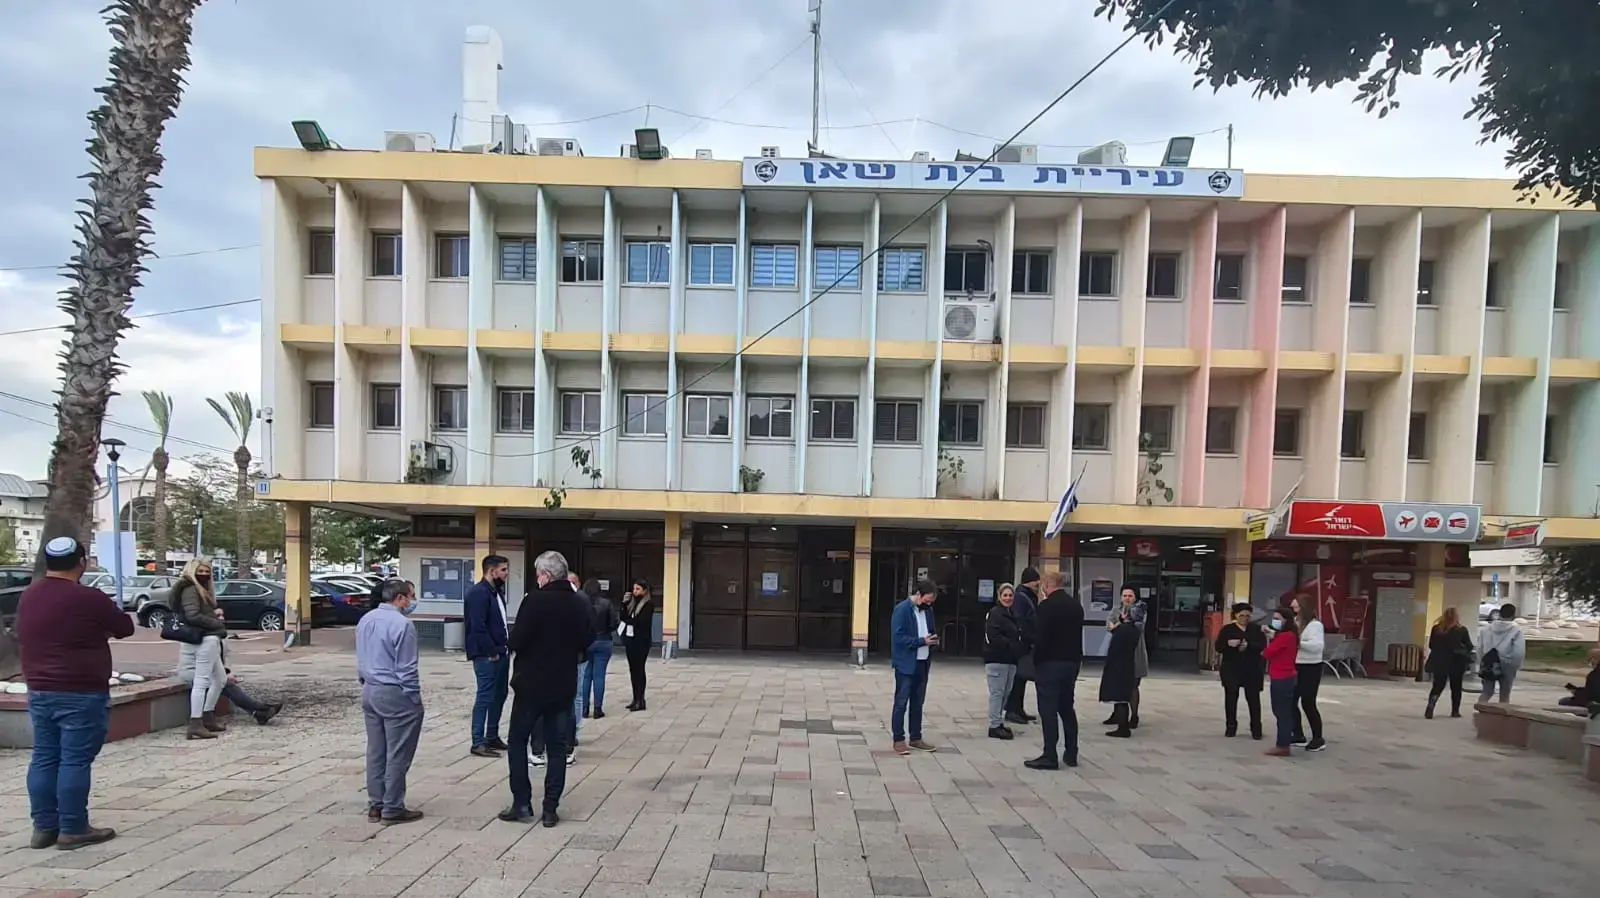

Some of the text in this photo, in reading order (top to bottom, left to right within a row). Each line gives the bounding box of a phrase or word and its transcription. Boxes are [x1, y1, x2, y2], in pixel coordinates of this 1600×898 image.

[800, 161, 1184, 187] עיריית בית שאן
